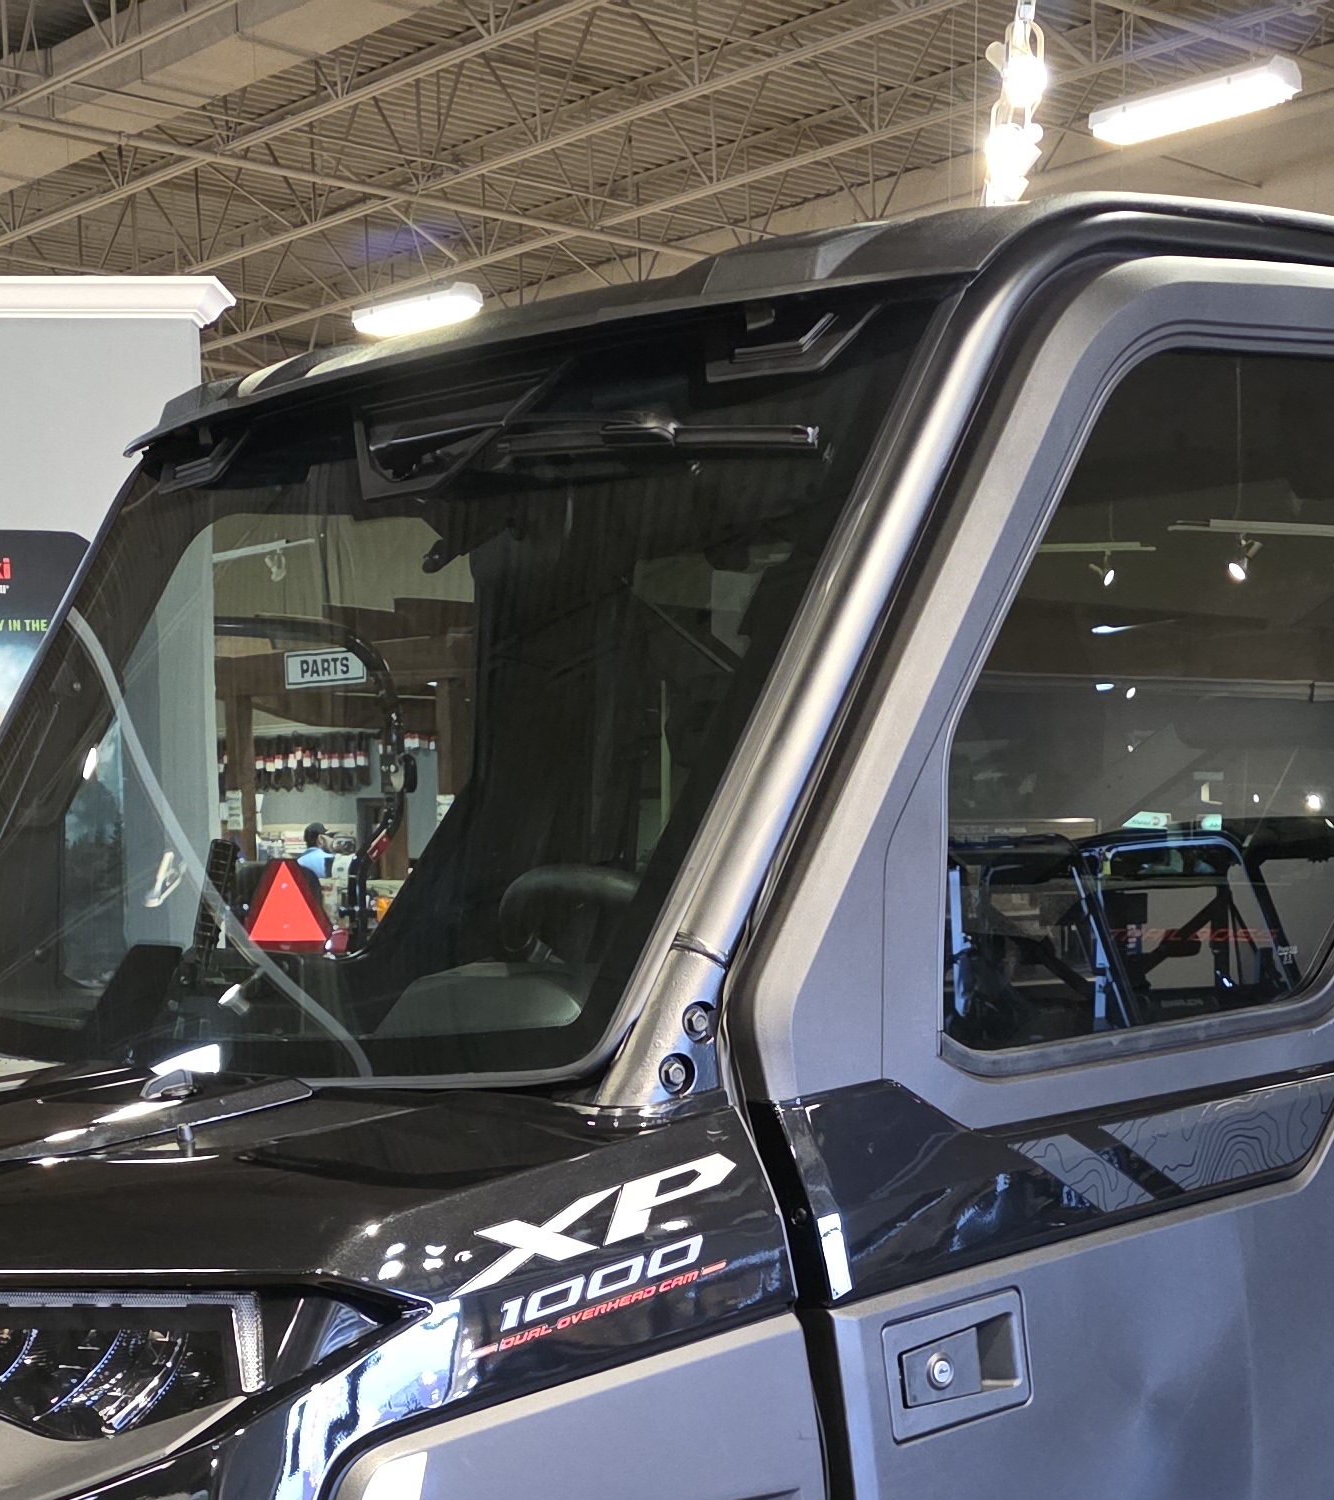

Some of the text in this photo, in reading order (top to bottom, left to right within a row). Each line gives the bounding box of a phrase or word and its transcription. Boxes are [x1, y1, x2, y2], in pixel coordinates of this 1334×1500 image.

[8, 619, 20, 631] IN
[24, 619, 48, 632] THE
[300, 656, 350, 678] PARTS
[449, 1151, 737, 1300] XP
[499, 1270, 700, 1350] DUAL OVERHEAD CAM
[500, 1234, 704, 1332] 1000
